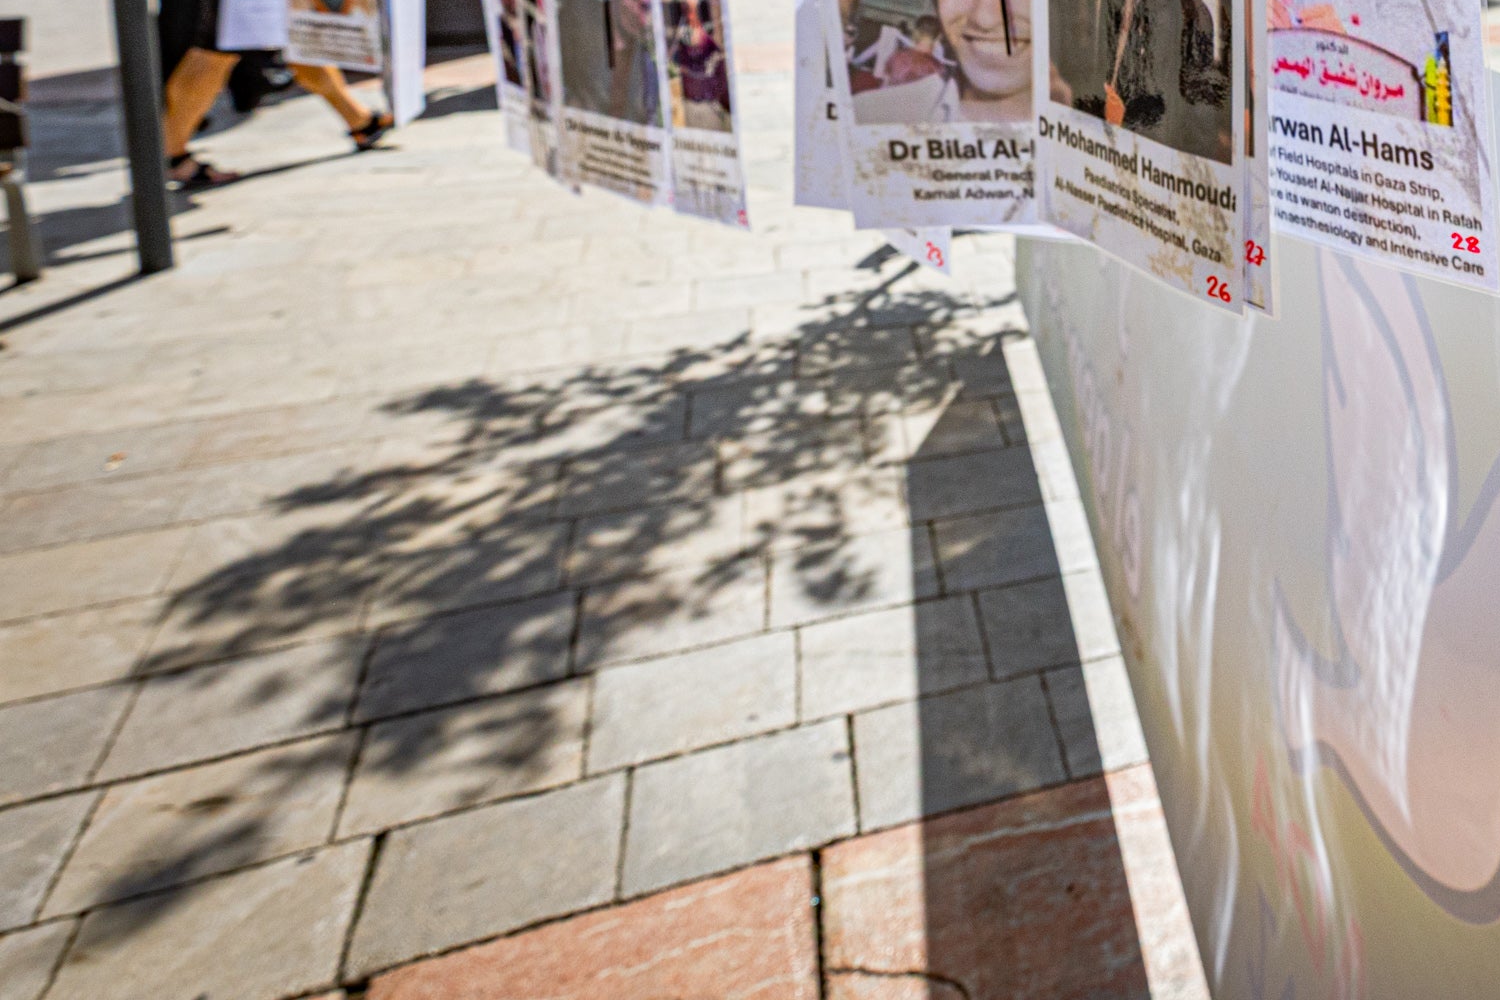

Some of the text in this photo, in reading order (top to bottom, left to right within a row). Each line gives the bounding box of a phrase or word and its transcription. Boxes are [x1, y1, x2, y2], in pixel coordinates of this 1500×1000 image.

[889, 141, 920, 160] Dr
[927, 140, 985, 159] Bilal
[1039, 116, 1054, 136] Dr
[1058, 123, 1138, 174] Mohammed
[1269, 114, 1434, 170] rwan Al-Hams
[1278, 150, 1444, 203] Field Hospitals in Gaza Strip,
[1372, 196, 1482, 231] Hospital in Rafah
[1192, 239, 1221, 263] Gaza
[1366, 236, 1484, 276] and Intensive Care
[1451, 233, 1481, 253] 28
[1206, 275, 1231, 303] 26
